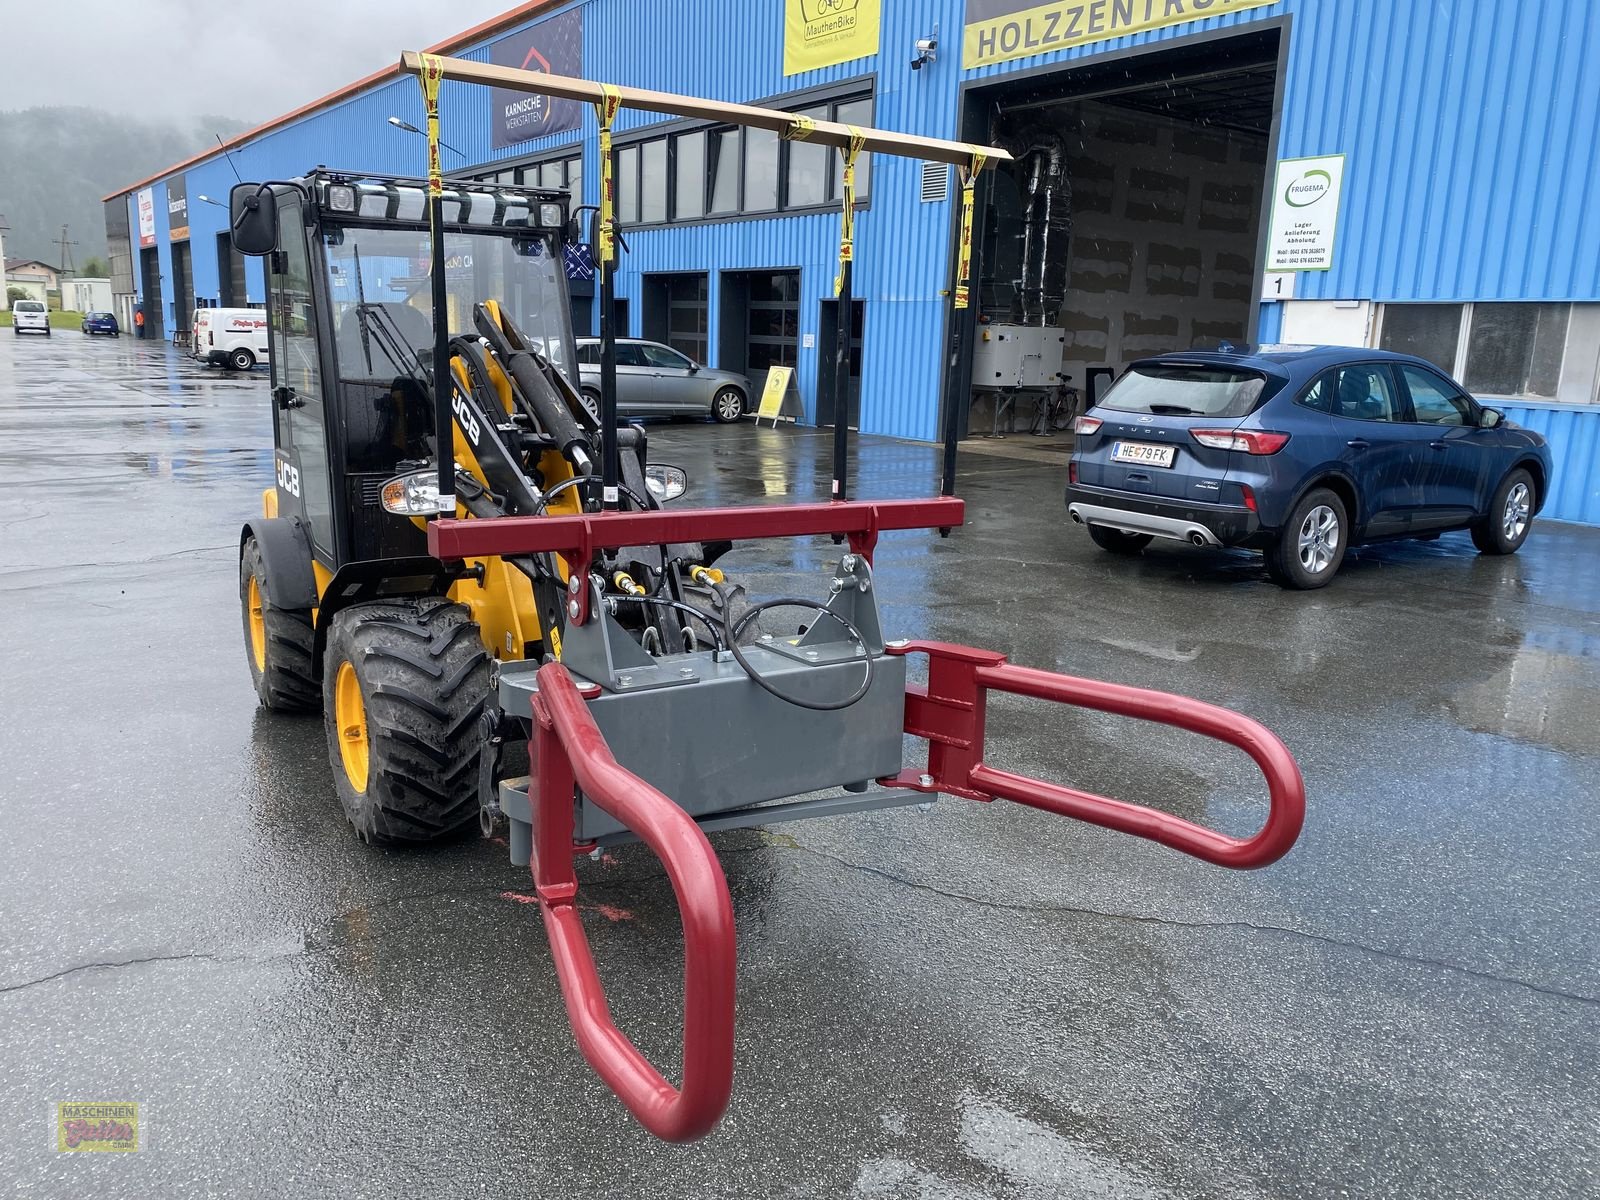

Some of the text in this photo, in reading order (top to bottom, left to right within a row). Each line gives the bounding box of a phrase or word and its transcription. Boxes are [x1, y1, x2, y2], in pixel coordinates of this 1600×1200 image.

[806, 16, 855, 37] MauthenBike
[978, 0, 1232, 58] HOLZZENTR
[505, 95, 541, 118] KARNISCHE
[1291, 184, 1324, 193] FRUGEMA
[1275, 277, 1282, 294] 1
[452, 388, 480, 446] JCB
[1122, 446, 1135, 457] HE
[277, 458, 300, 498] JCB
